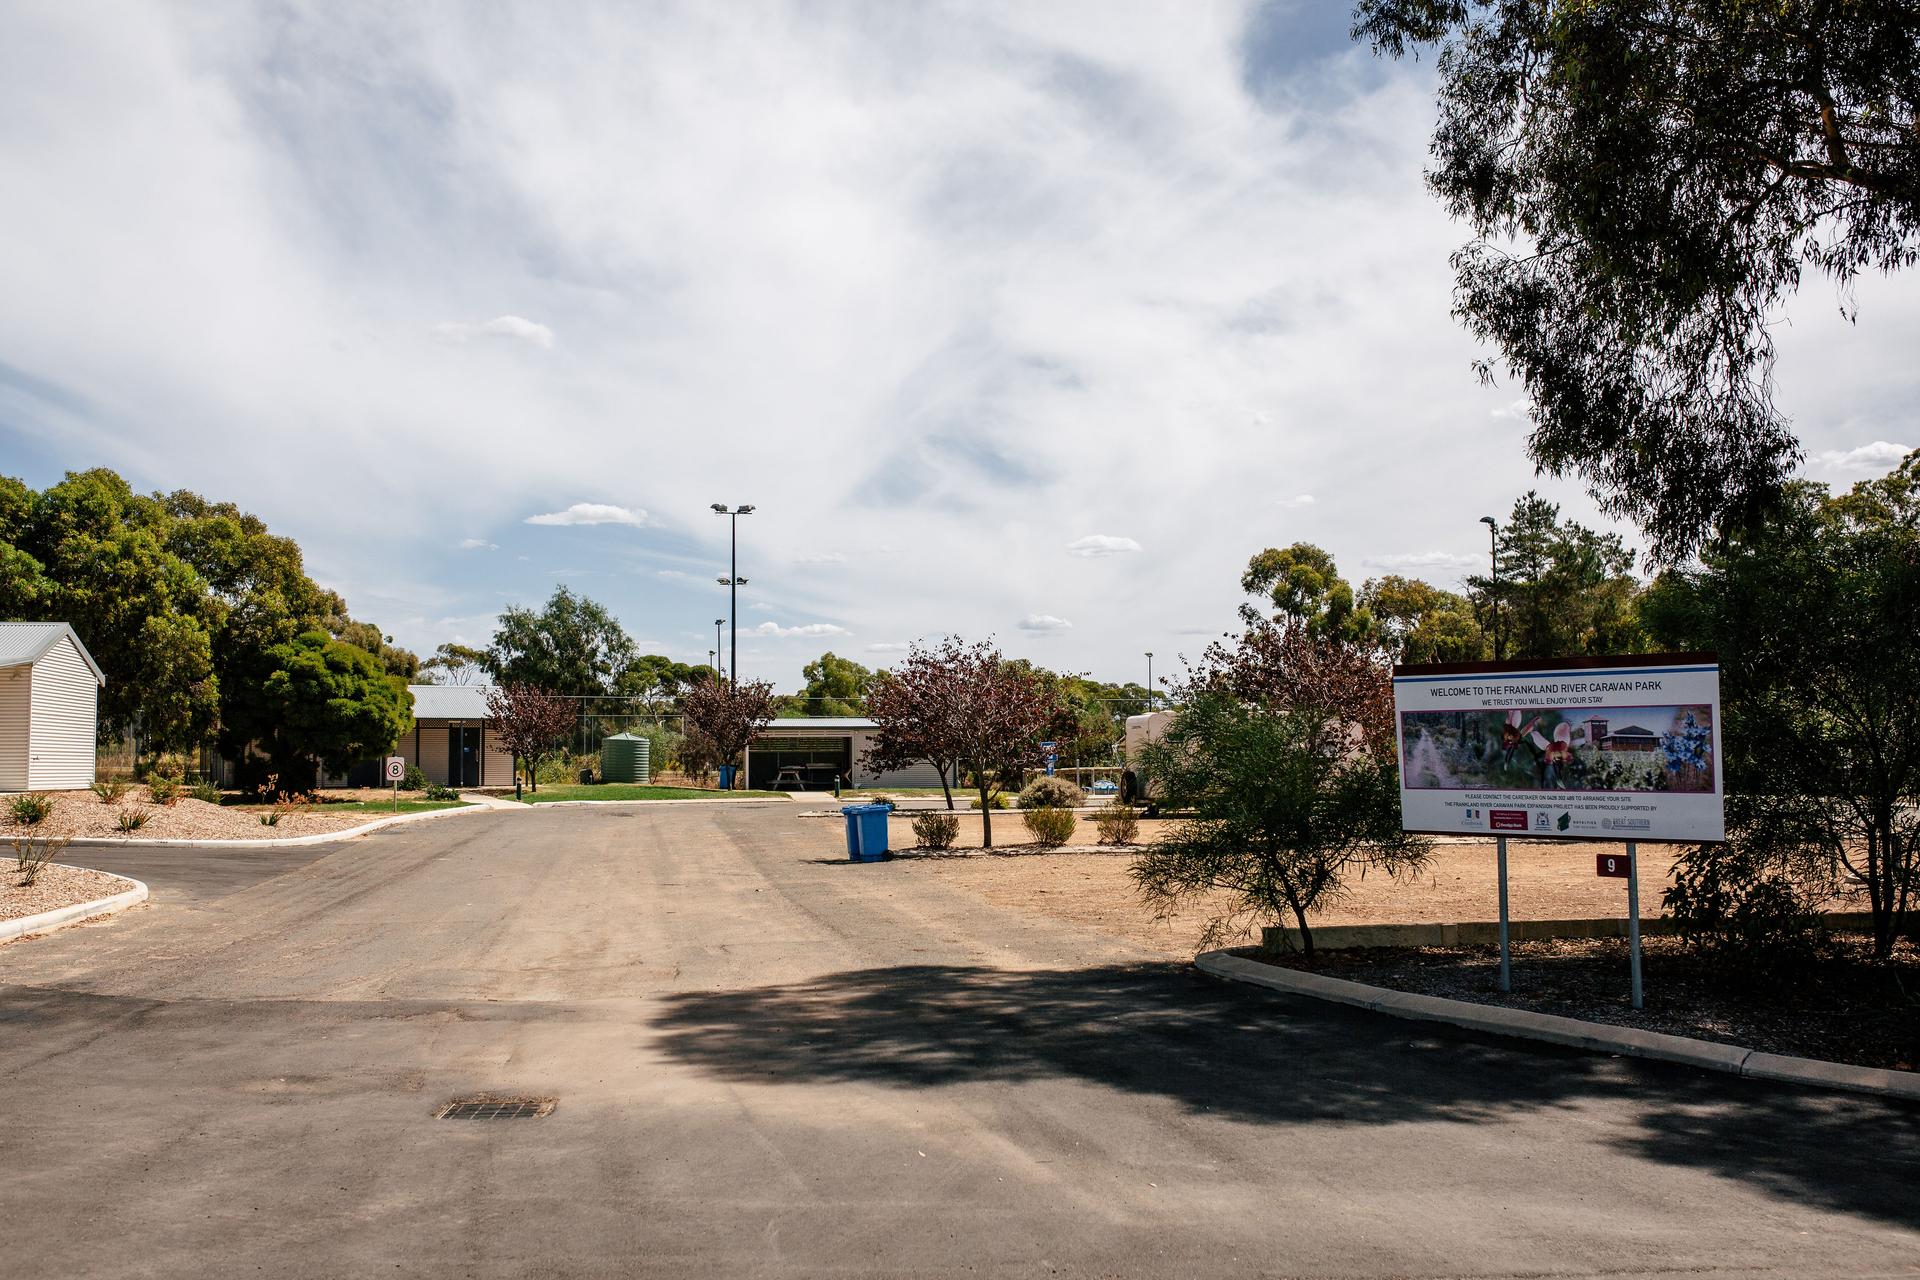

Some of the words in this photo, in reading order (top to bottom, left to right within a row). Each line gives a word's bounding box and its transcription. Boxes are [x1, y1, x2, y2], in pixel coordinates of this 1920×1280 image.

[1430, 687, 1471, 697] WELCOME
[1473, 686, 1484, 696] TO
[1485, 686, 1502, 695] THE
[1504, 684, 1559, 695] FRANKLAND
[1561, 683, 1587, 693] RIVER
[1589, 681, 1633, 692] CARAVAN
[1635, 680, 1662, 691] PARK
[1493, 698, 1513, 706] TRUST
[1528, 697, 1545, 705] WILL
[1546, 697, 1567, 705] ENJOY
[1568, 696, 1587, 704] YOUR
[393, 765, 398, 774] 8
[1608, 859, 1615, 872] 9
